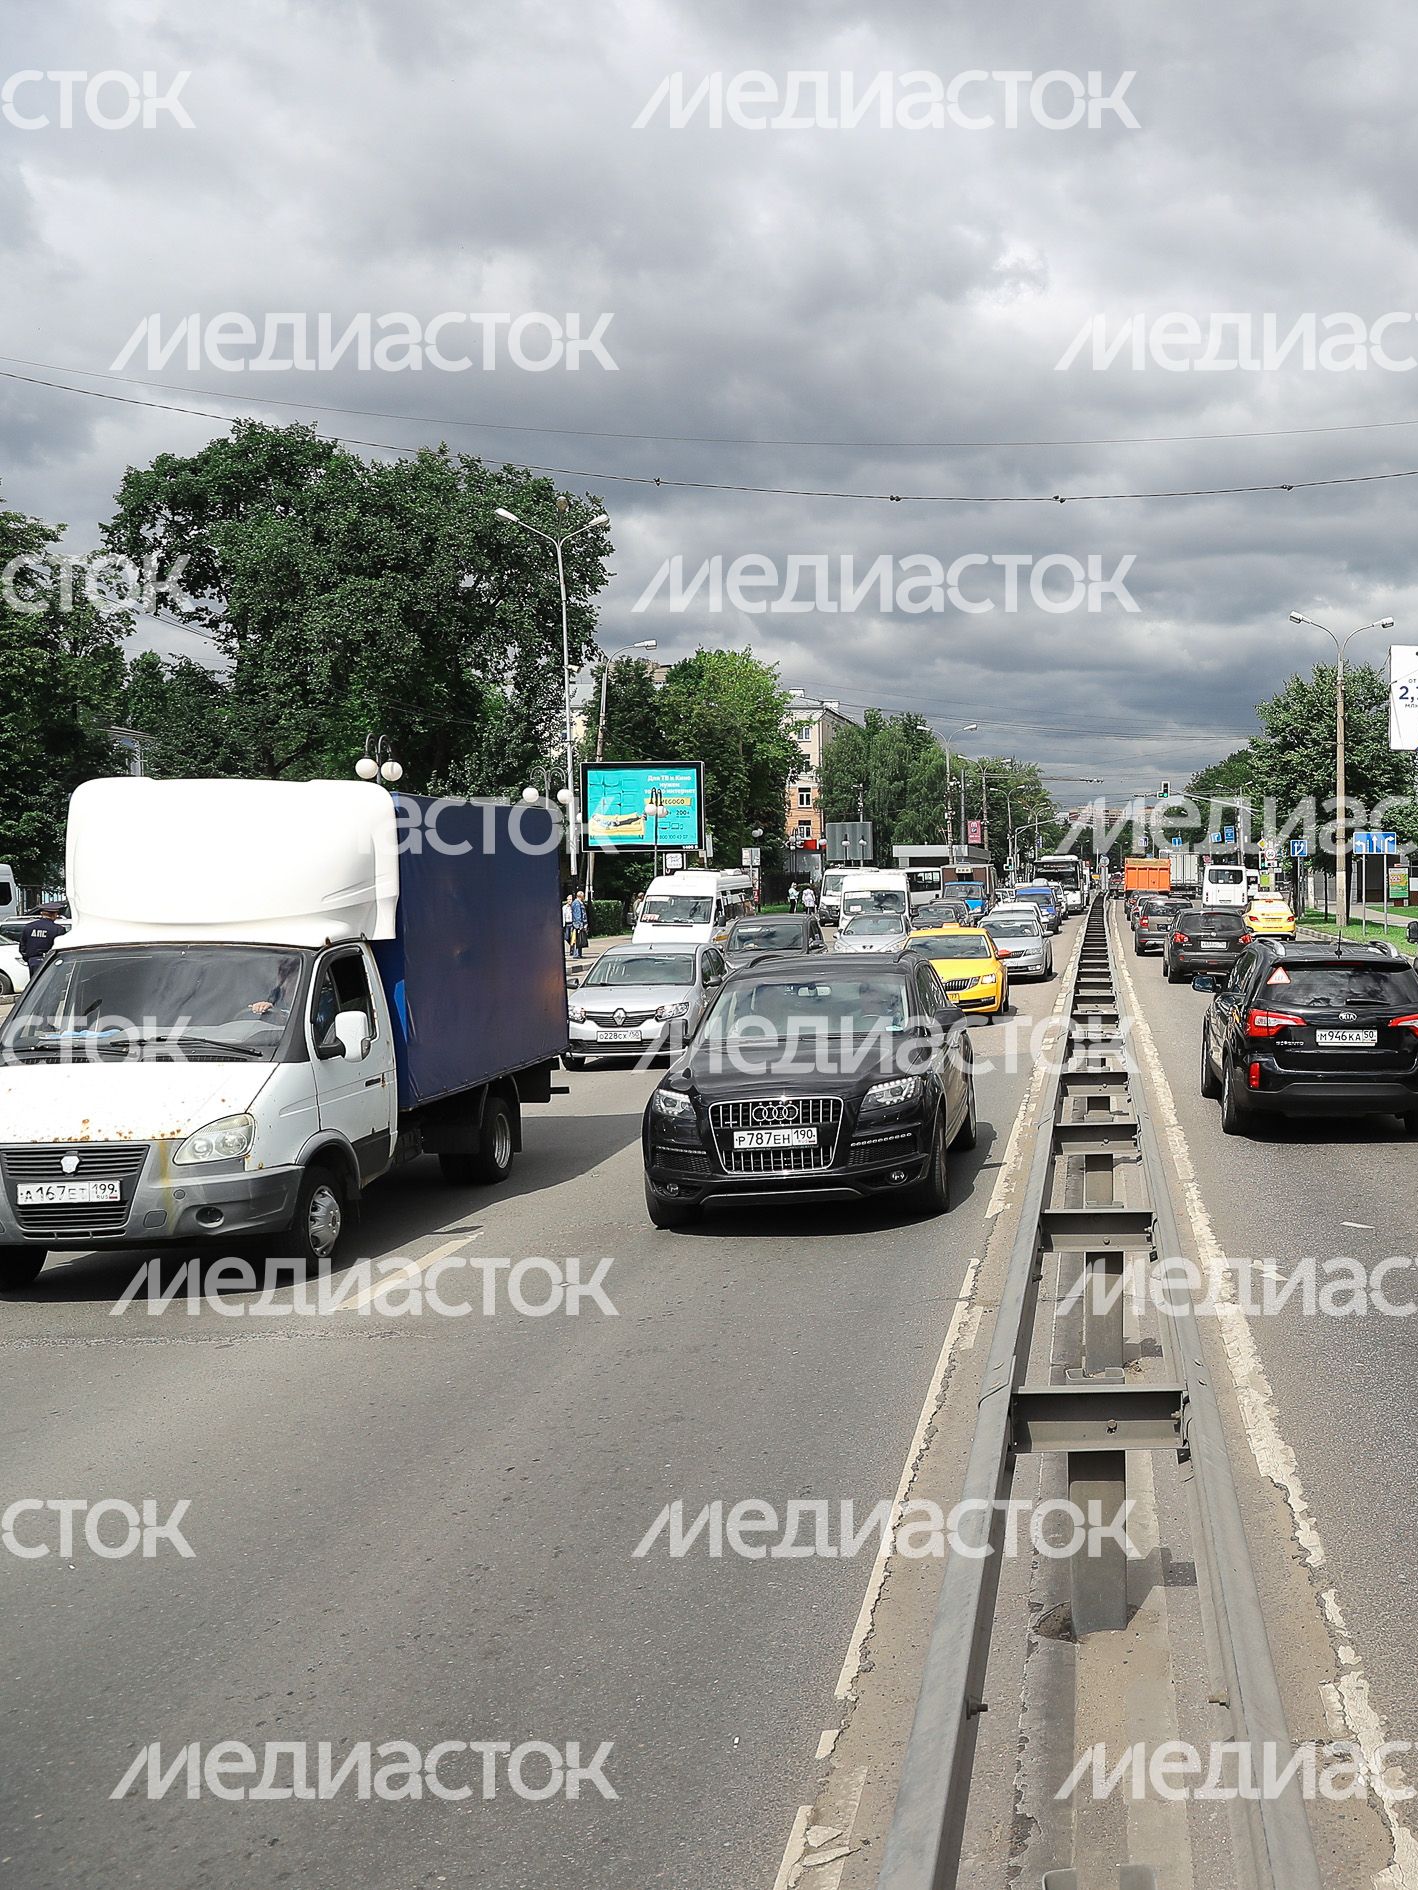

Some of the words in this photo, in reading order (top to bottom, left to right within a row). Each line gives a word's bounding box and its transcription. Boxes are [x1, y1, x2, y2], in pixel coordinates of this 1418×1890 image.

[1340, 1013, 1356, 1021] KIA
[1319, 1030, 1361, 1041] М946КА
[1363, 1030, 1374, 1039] 50
[738, 1131, 790, 1146] Р787ЕН
[793, 1129, 813, 1140] 190
[92, 1183, 115, 1195] 199
